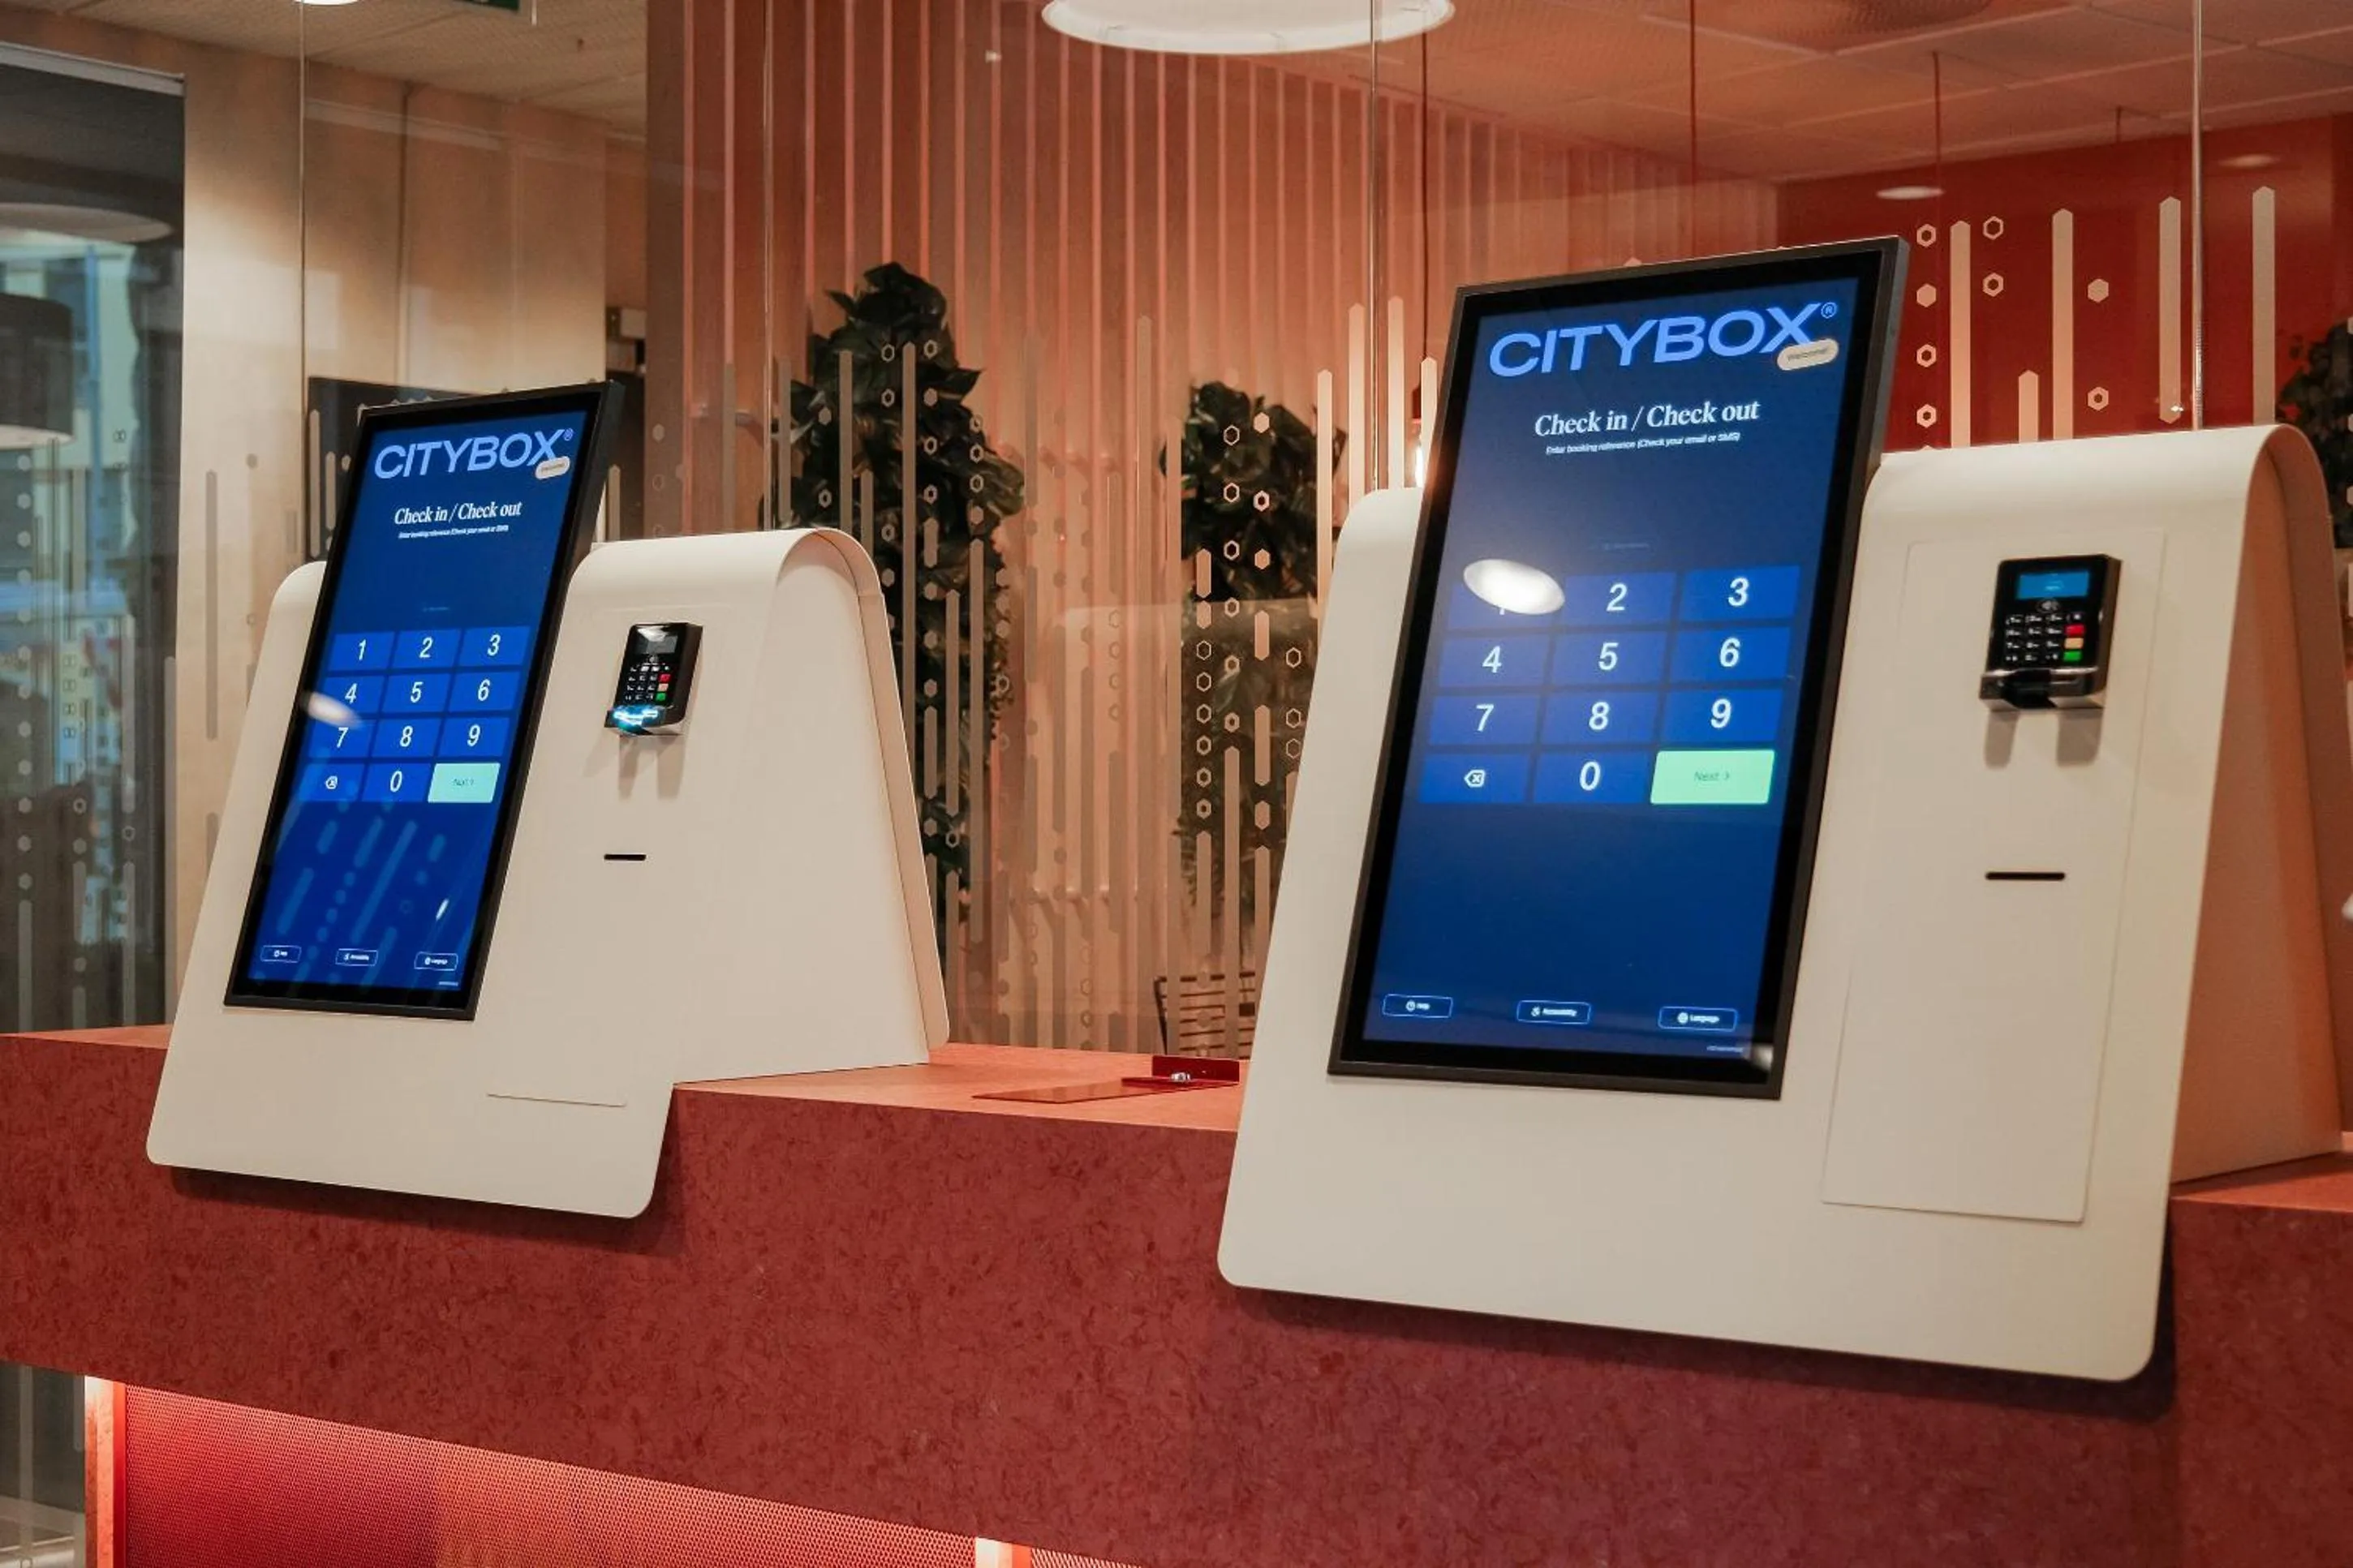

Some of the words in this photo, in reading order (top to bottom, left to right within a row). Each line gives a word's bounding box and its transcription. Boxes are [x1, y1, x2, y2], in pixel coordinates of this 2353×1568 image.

[1535, 410, 1602, 436] Check
[1606, 410, 1628, 431] in
[1646, 401, 1718, 427] Check
[1721, 401, 1762, 421] out
[394, 506, 433, 525] Check
[434, 506, 448, 522] in
[458, 501, 498, 520] Check
[500, 501, 523, 517] out
[1607, 583, 1628, 612] 2
[1728, 578, 1749, 606] 3
[359, 639, 366, 660] 1
[419, 637, 433, 658] 2
[487, 634, 501, 656] 3
[1482, 645, 1502, 673] 4
[1598, 642, 1619, 671] 5
[1720, 638, 1740, 667] 6
[345, 683, 357, 703] 4
[410, 681, 423, 703] 5
[478, 679, 491, 702] 6
[1476, 703, 1495, 731] 7
[1589, 702, 1609, 730] 8
[1711, 698, 1731, 728] 9
[337, 727, 349, 748] 7
[399, 725, 413, 747] 8
[467, 724, 481, 747] 9
[389, 771, 402, 793] 0
[1580, 762, 1601, 791] 0
[1694, 771, 1719, 782] Next
